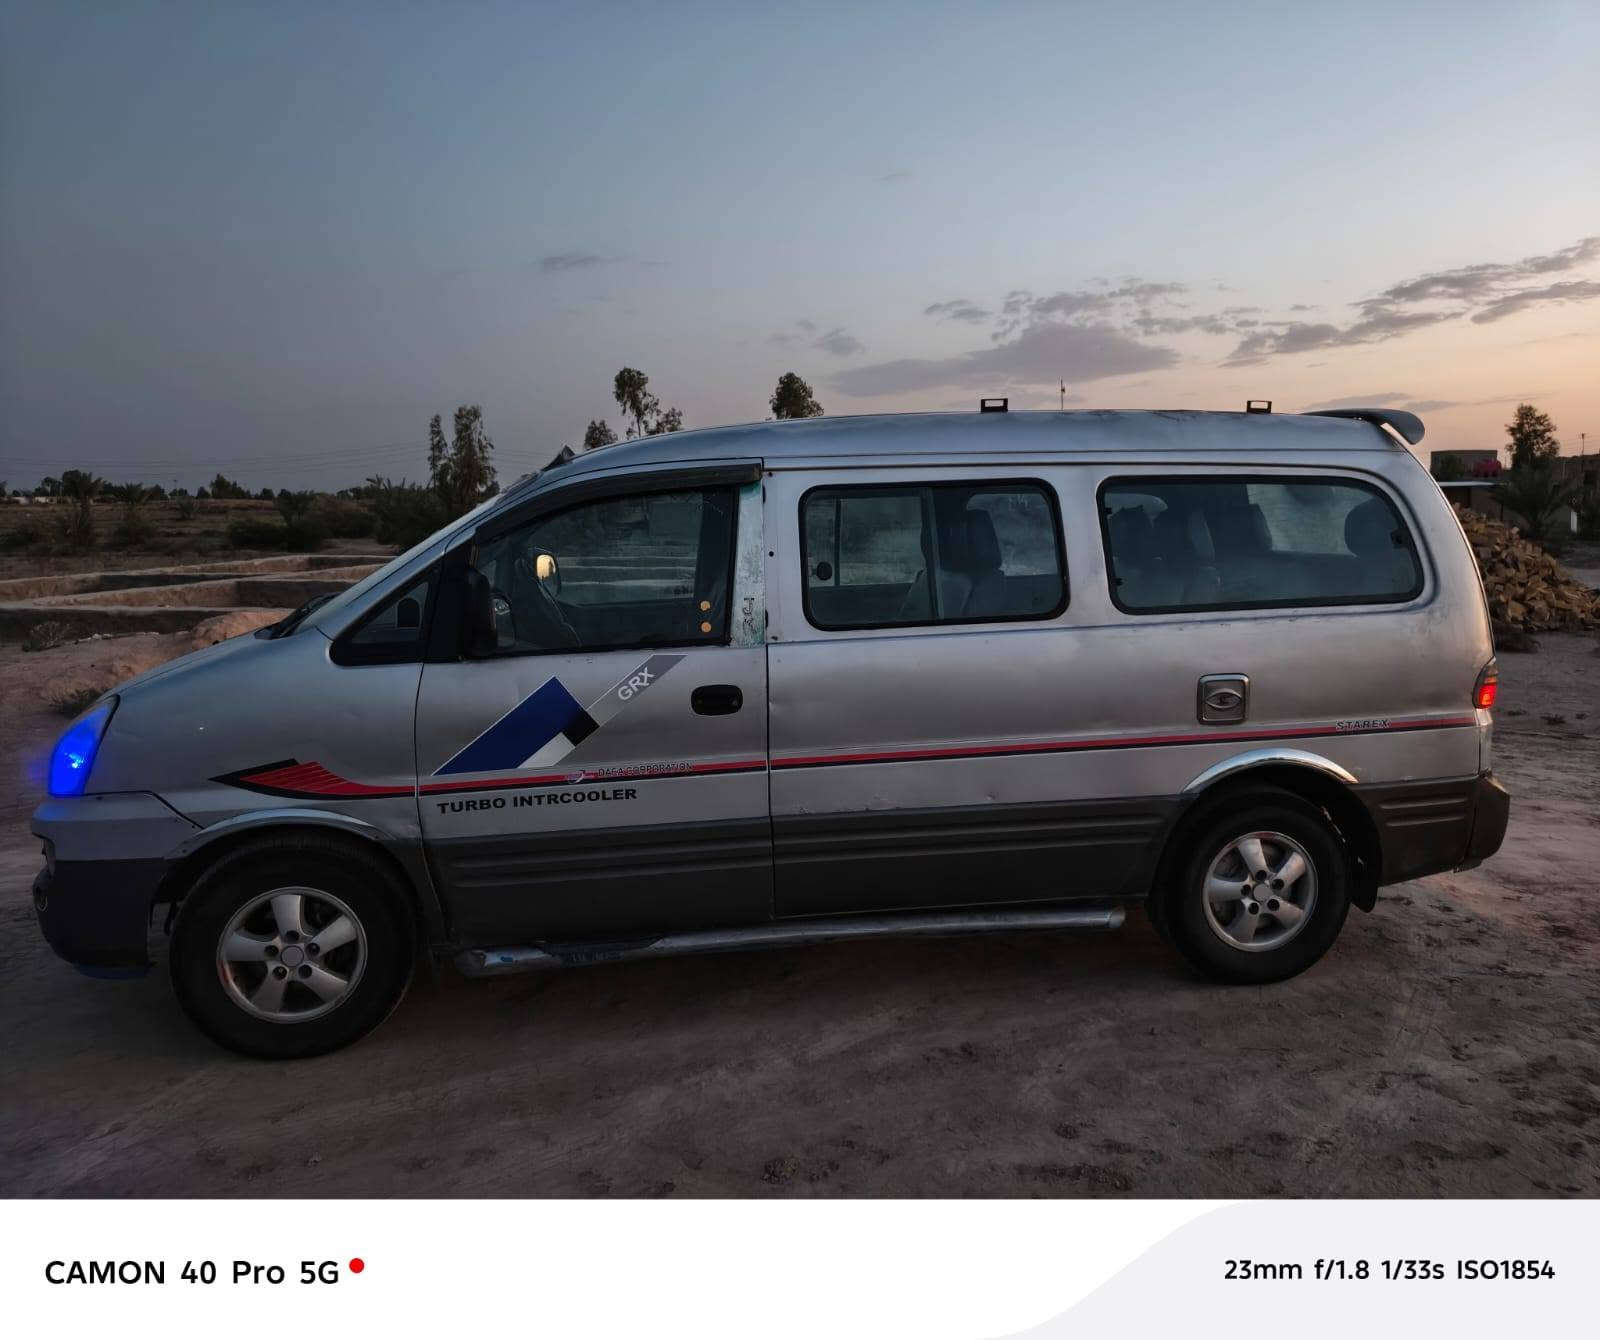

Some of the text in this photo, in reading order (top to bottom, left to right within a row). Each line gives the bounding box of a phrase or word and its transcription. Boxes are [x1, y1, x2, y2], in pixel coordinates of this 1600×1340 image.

[618, 667, 655, 700] GRX
[1337, 719, 1392, 731] STAREX
[437, 788, 637, 814] TURBO INTRCOOLER
